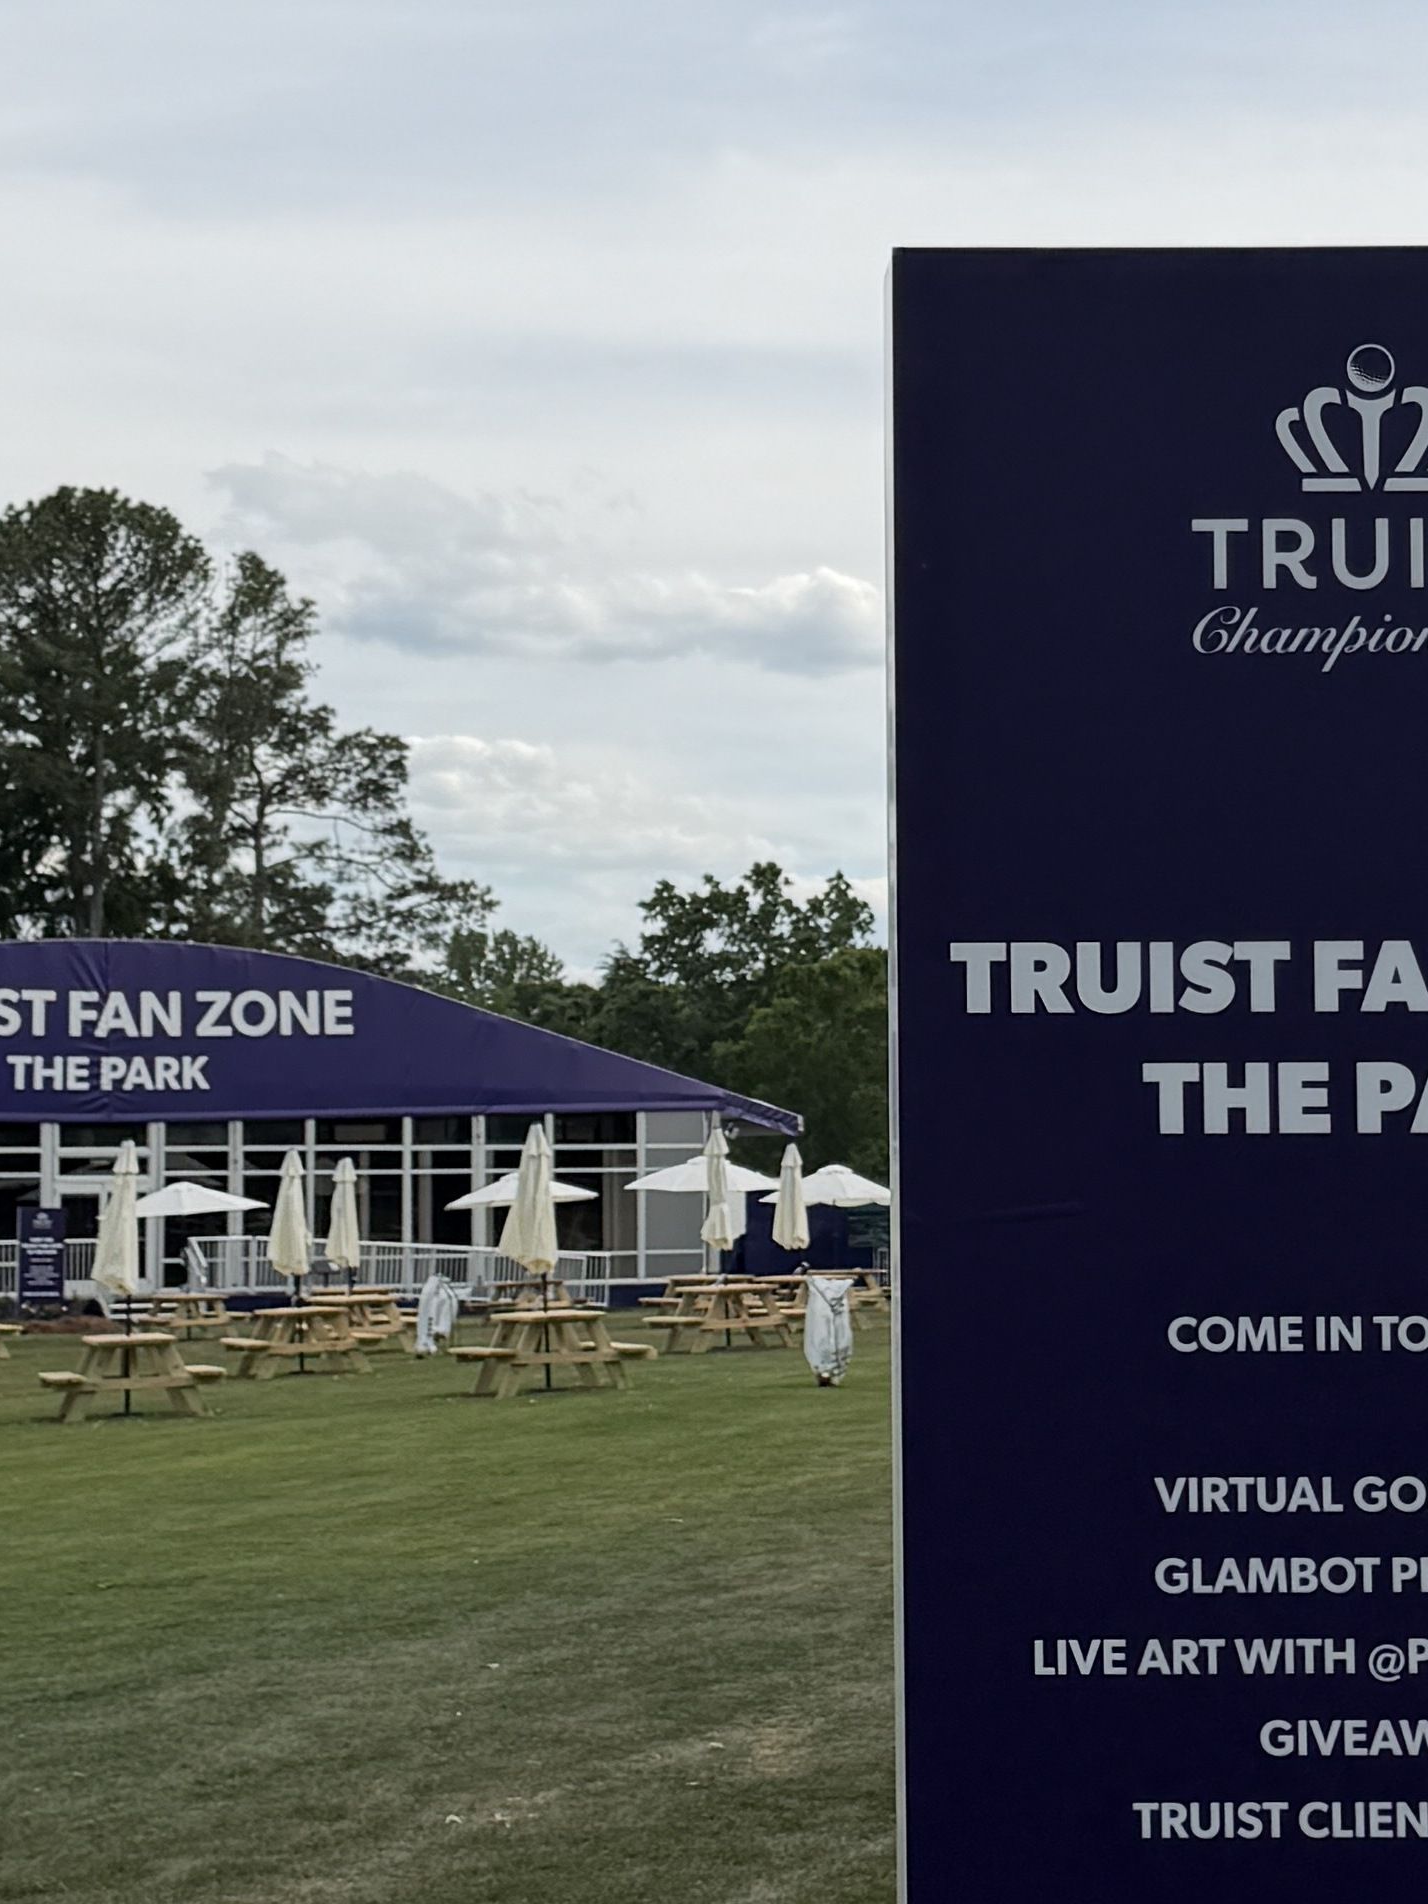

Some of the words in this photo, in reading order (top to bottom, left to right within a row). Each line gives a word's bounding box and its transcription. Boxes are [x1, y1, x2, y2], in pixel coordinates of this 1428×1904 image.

[949, 940, 1291, 1015] TRUIST
[68, 990, 182, 1038] FAN
[195, 989, 355, 1037] ZONE
[6, 1055, 90, 1091] THE
[100, 1055, 210, 1091] PARK
[1142, 1061, 1332, 1135] THE
[1167, 1315, 1304, 1353] COME
[1315, 1315, 1363, 1352] IN
[1153, 1476, 1344, 1513] VIRTUAL
[1154, 1556, 1381, 1594] GLAMBOT
[1033, 1638, 1128, 1676] LIVE
[1137, 1638, 1226, 1675] ART
[1233, 1638, 1356, 1675] WITH
[1132, 1801, 1289, 1839] TRUIST
